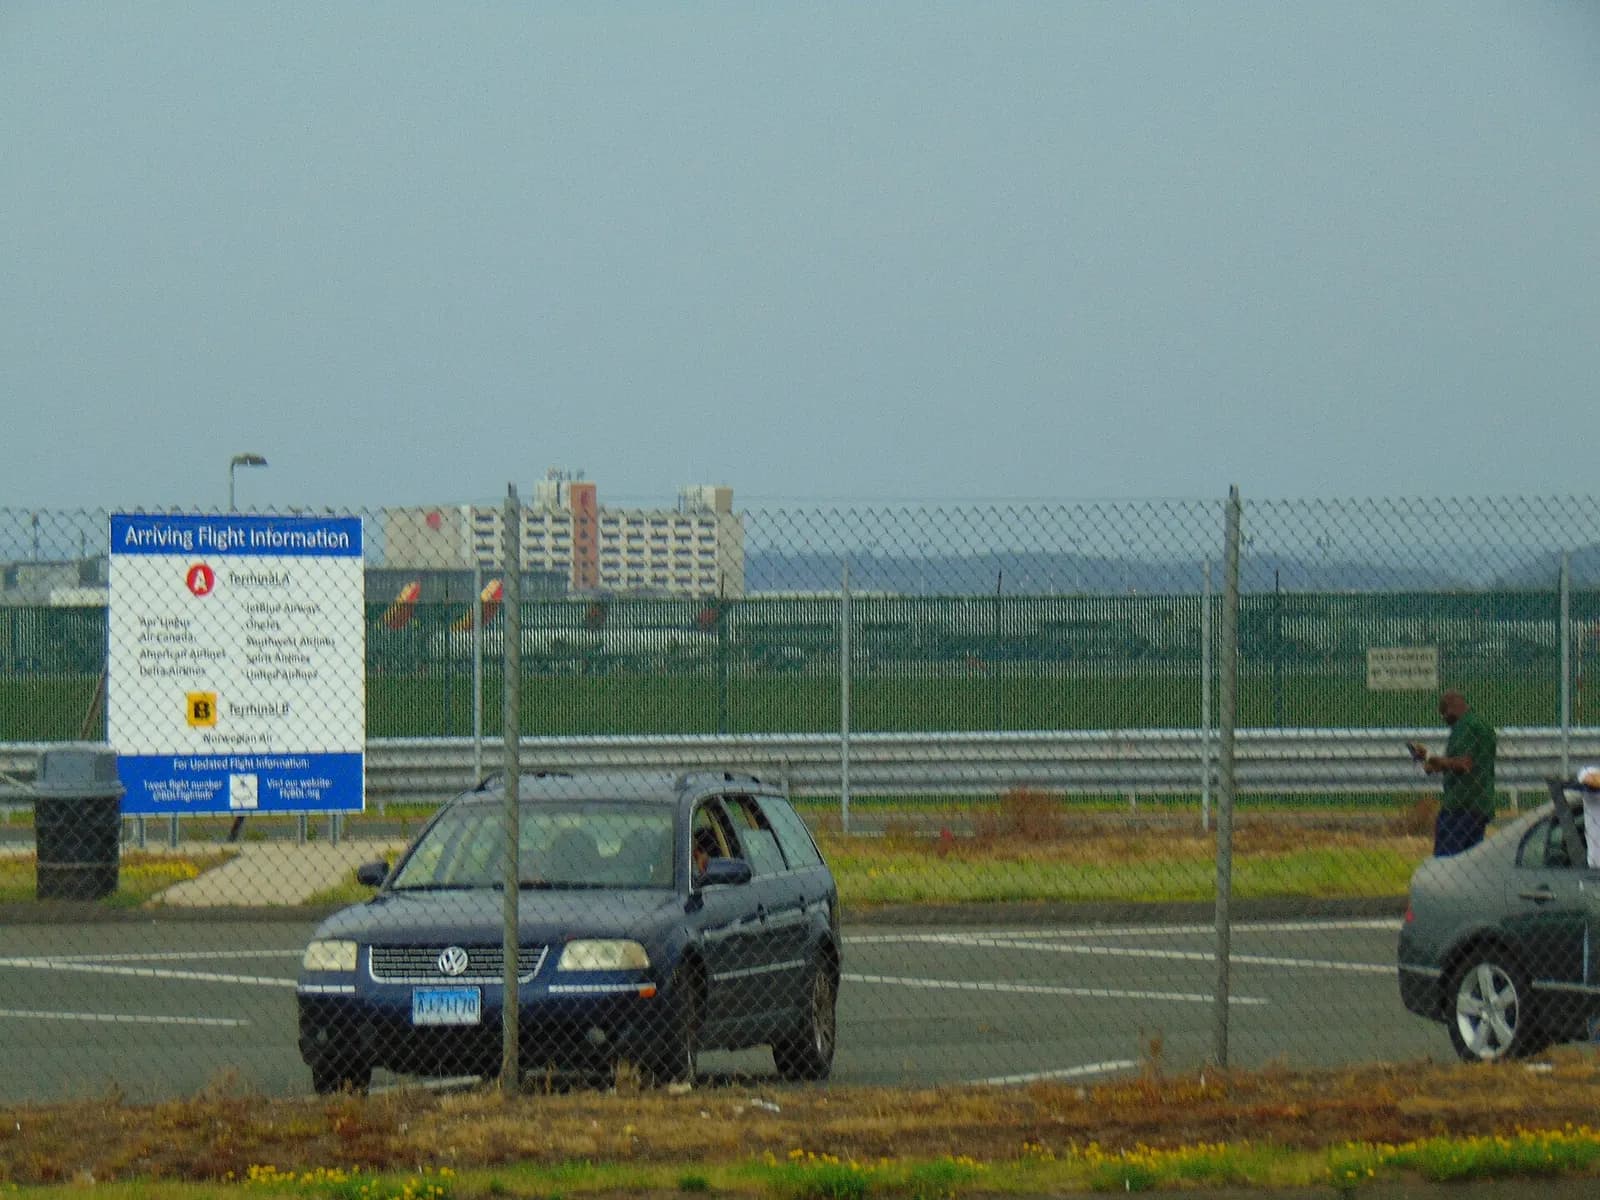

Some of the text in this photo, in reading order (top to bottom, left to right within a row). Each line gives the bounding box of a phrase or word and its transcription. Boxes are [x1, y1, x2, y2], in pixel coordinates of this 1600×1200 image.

[125, 525, 350, 550] Arriving Flight Information
[194, 569, 208, 592] A
[229, 572, 279, 585] Terminal
[194, 701, 210, 719] B
[229, 703, 278, 716] Terminal
[174, 758, 188, 770] For
[190, 758, 228, 771] Updated
[230, 757, 255, 772] Flight
